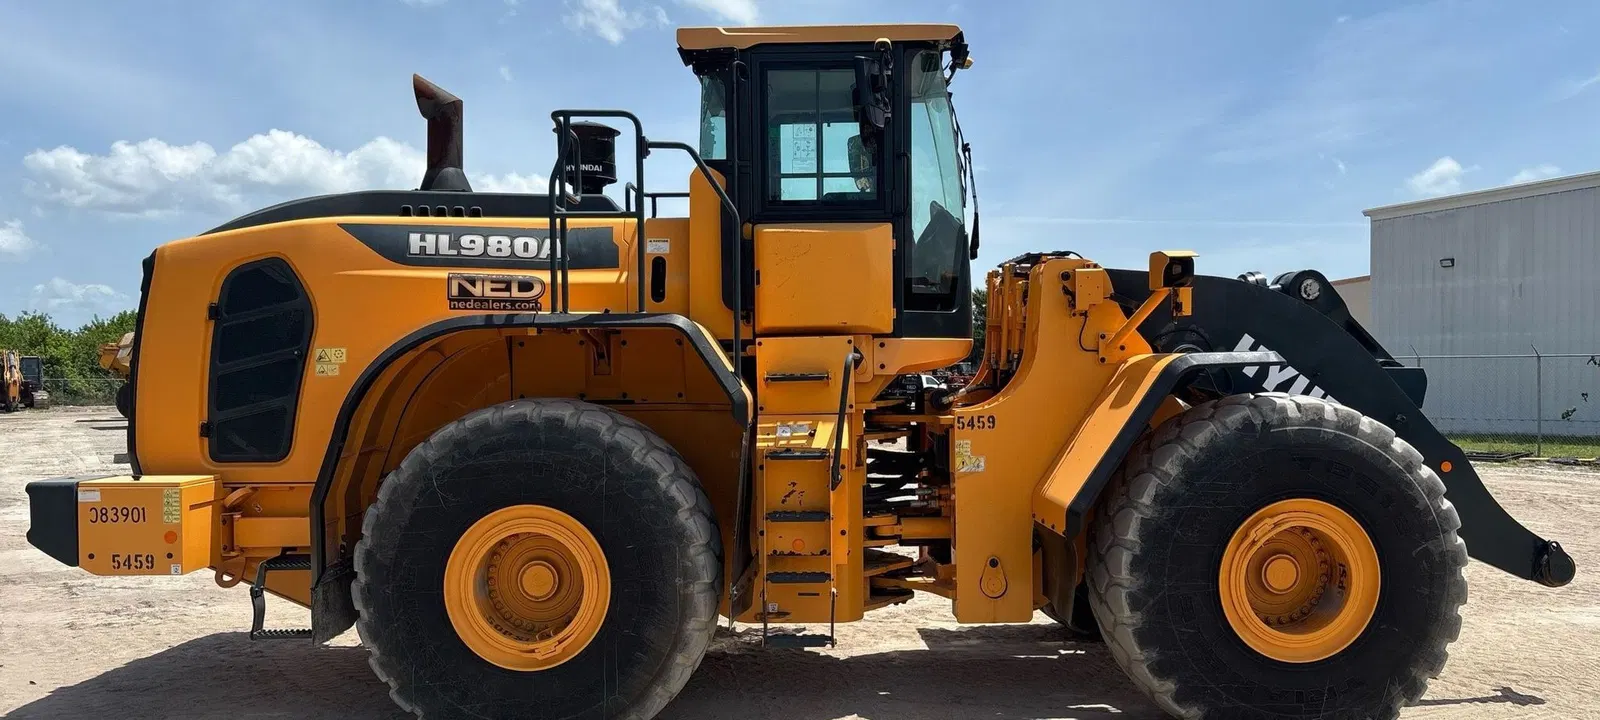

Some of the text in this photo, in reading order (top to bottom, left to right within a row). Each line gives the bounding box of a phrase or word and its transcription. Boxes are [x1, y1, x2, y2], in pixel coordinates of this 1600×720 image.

[408, 232, 562, 258] HL980A
[450, 274, 543, 298] NED
[450, 300, 540, 310] nedealers.com
[956, 414, 996, 431] 5459
[111, 553, 155, 570] 5459
